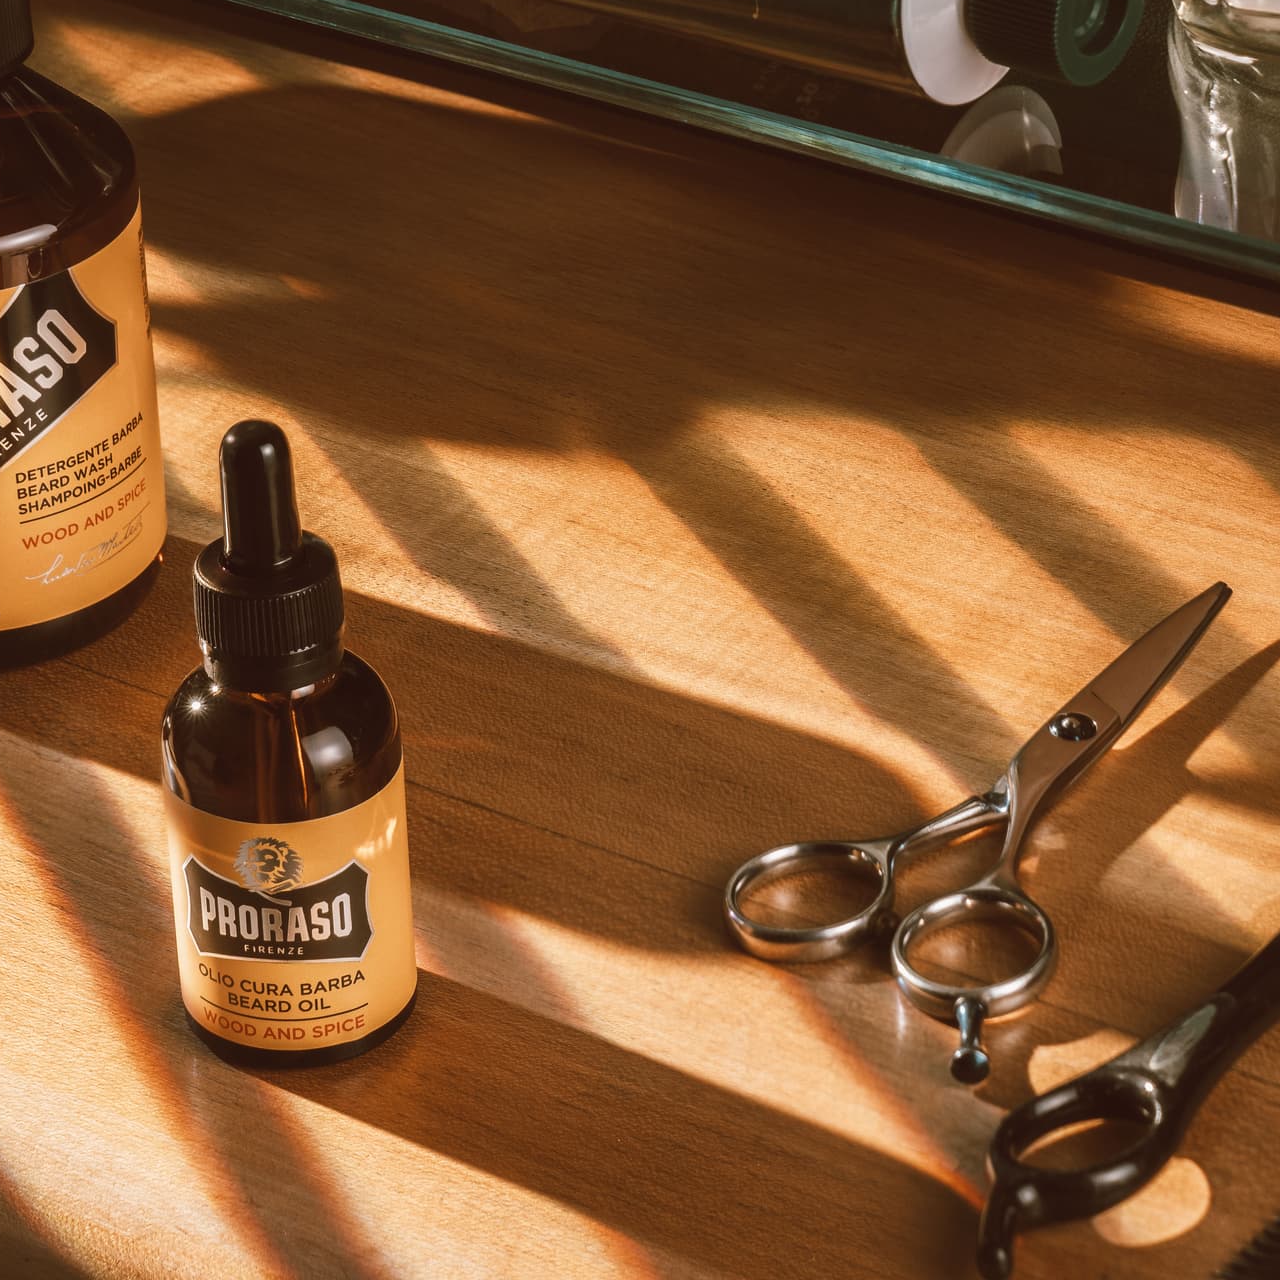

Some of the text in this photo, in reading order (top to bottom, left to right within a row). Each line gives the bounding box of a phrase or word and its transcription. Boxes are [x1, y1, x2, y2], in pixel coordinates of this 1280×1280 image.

[15, 410, 144, 485] DETERGENTE BARBA
[16, 452, 114, 500] BEARD WASH
[17, 445, 143, 516] SHAMPOING-BARBE
[21, 522, 80, 551] WOOD
[83, 504, 115, 531] AND
[116, 476, 147, 512] SPICE
[199, 886, 354, 943] PRORASO
[243, 943, 305, 956] FIRENZE
[198, 962, 366, 997] OLIO CURA BARBA
[227, 994, 332, 1013] BEARD OIL
[203, 1006, 367, 1041] WOOD AND SPICE
